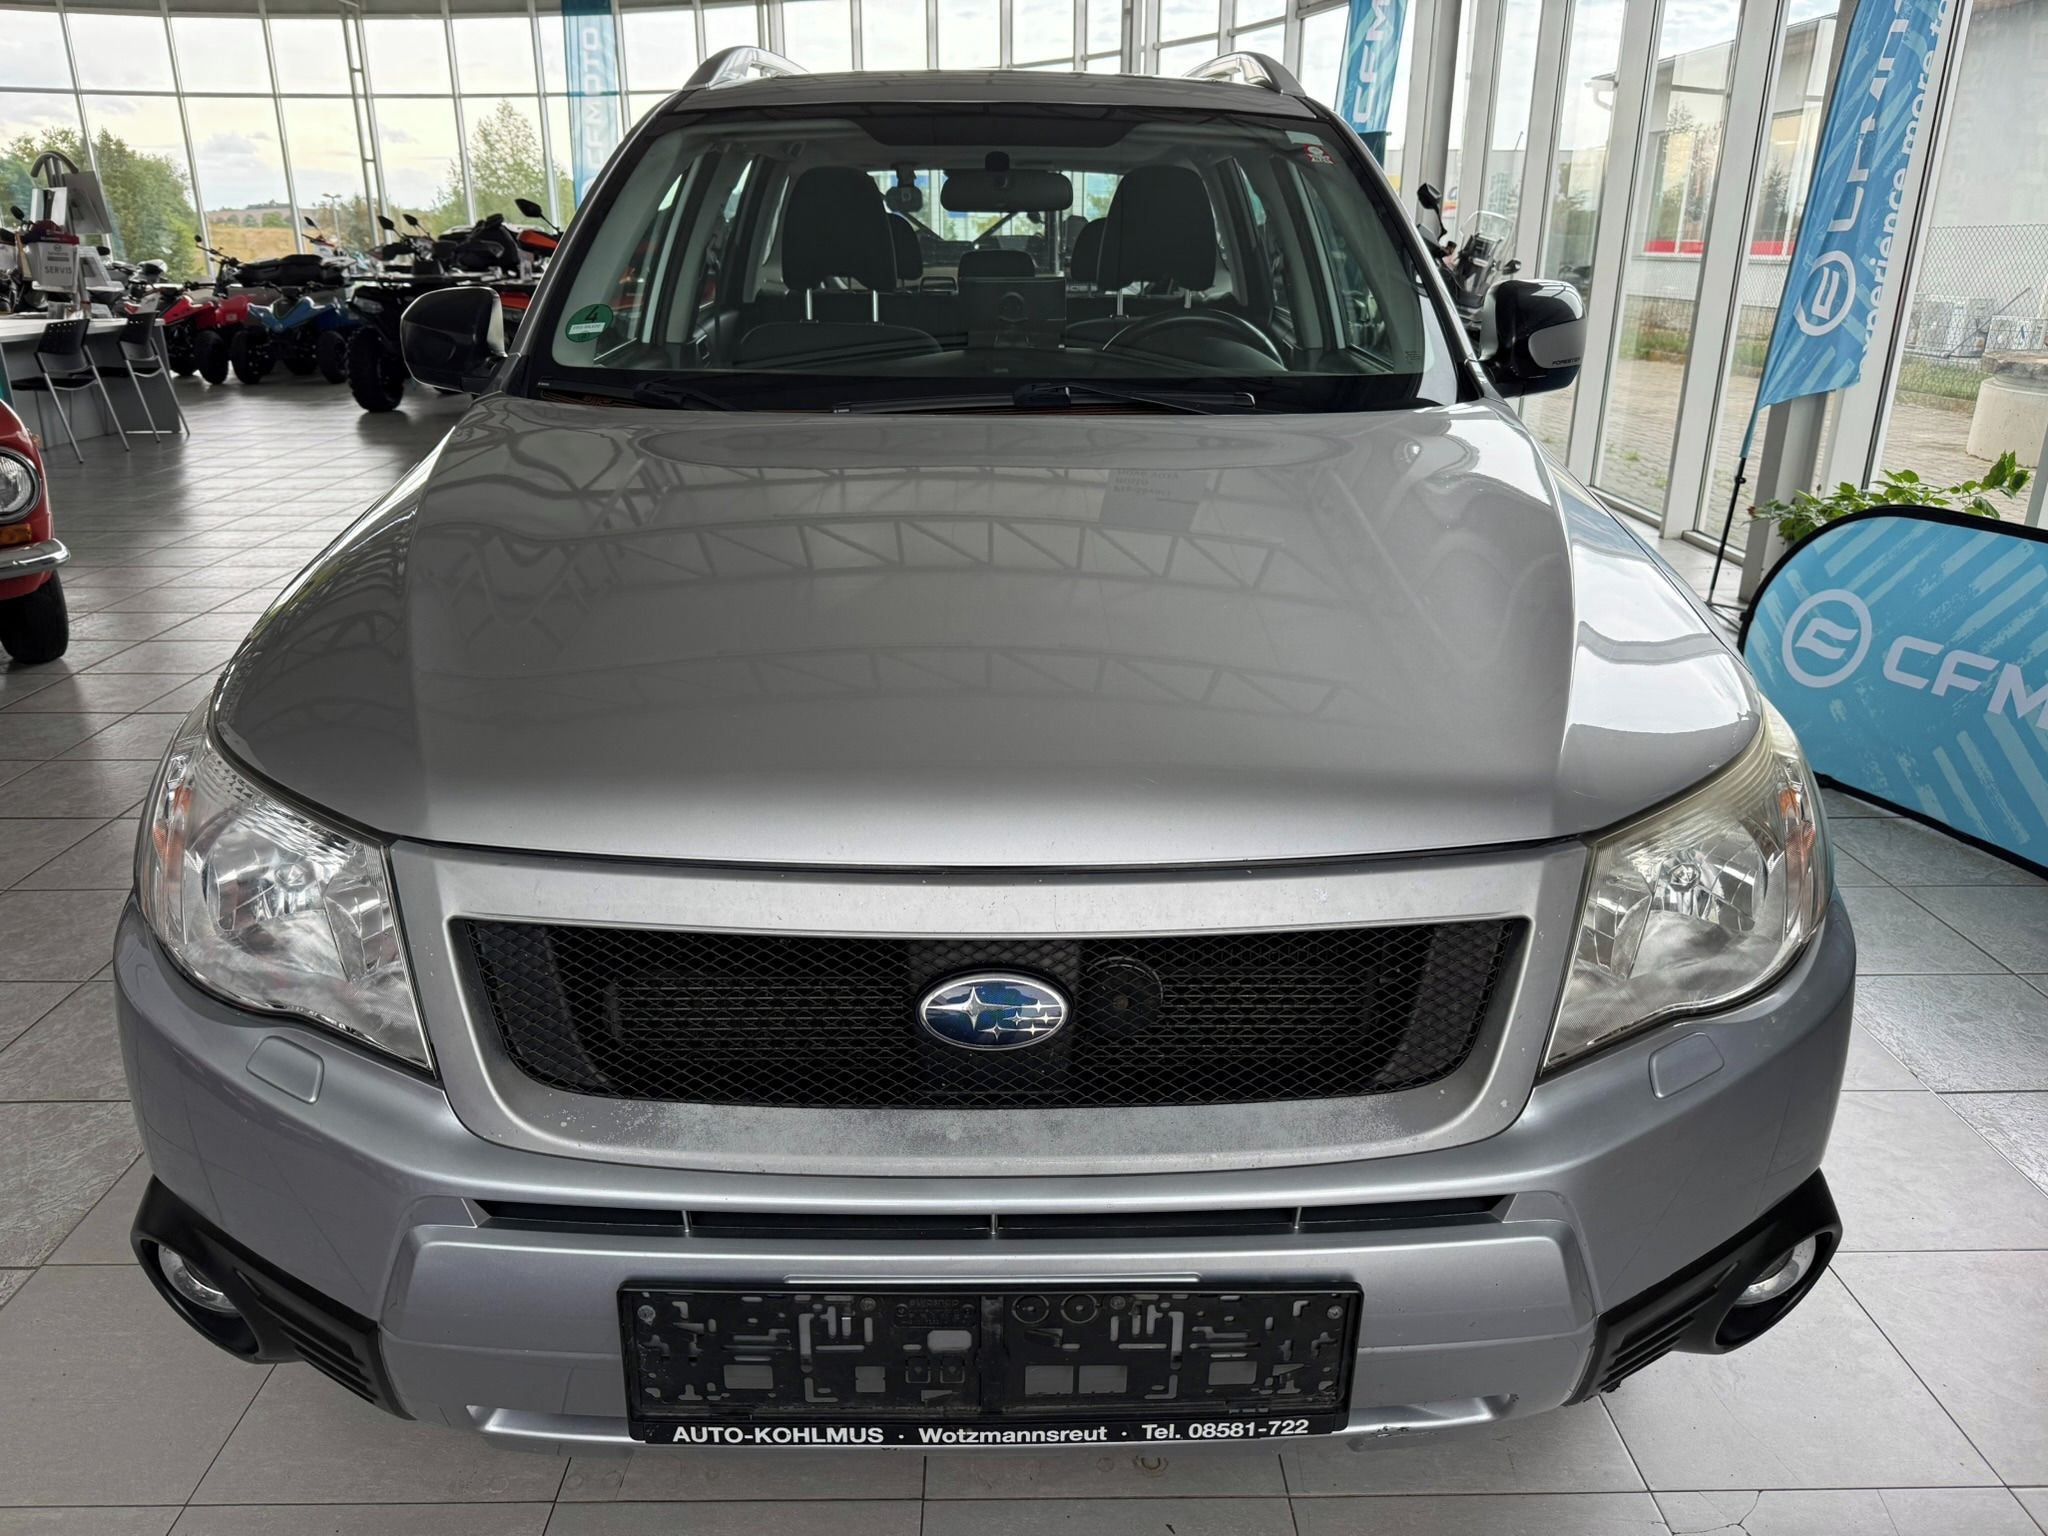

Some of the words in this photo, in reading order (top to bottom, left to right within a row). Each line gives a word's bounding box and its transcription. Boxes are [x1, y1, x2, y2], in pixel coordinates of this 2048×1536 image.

[585, 305, 600, 323] 4
[672, 1426, 884, 1444] AUTO-KOHLMUS
[918, 1426, 1108, 1443] Wotzmannsreut
[1142, 1423, 1181, 1439] Tel.
[1188, 1418, 1310, 1438] 08581-722
